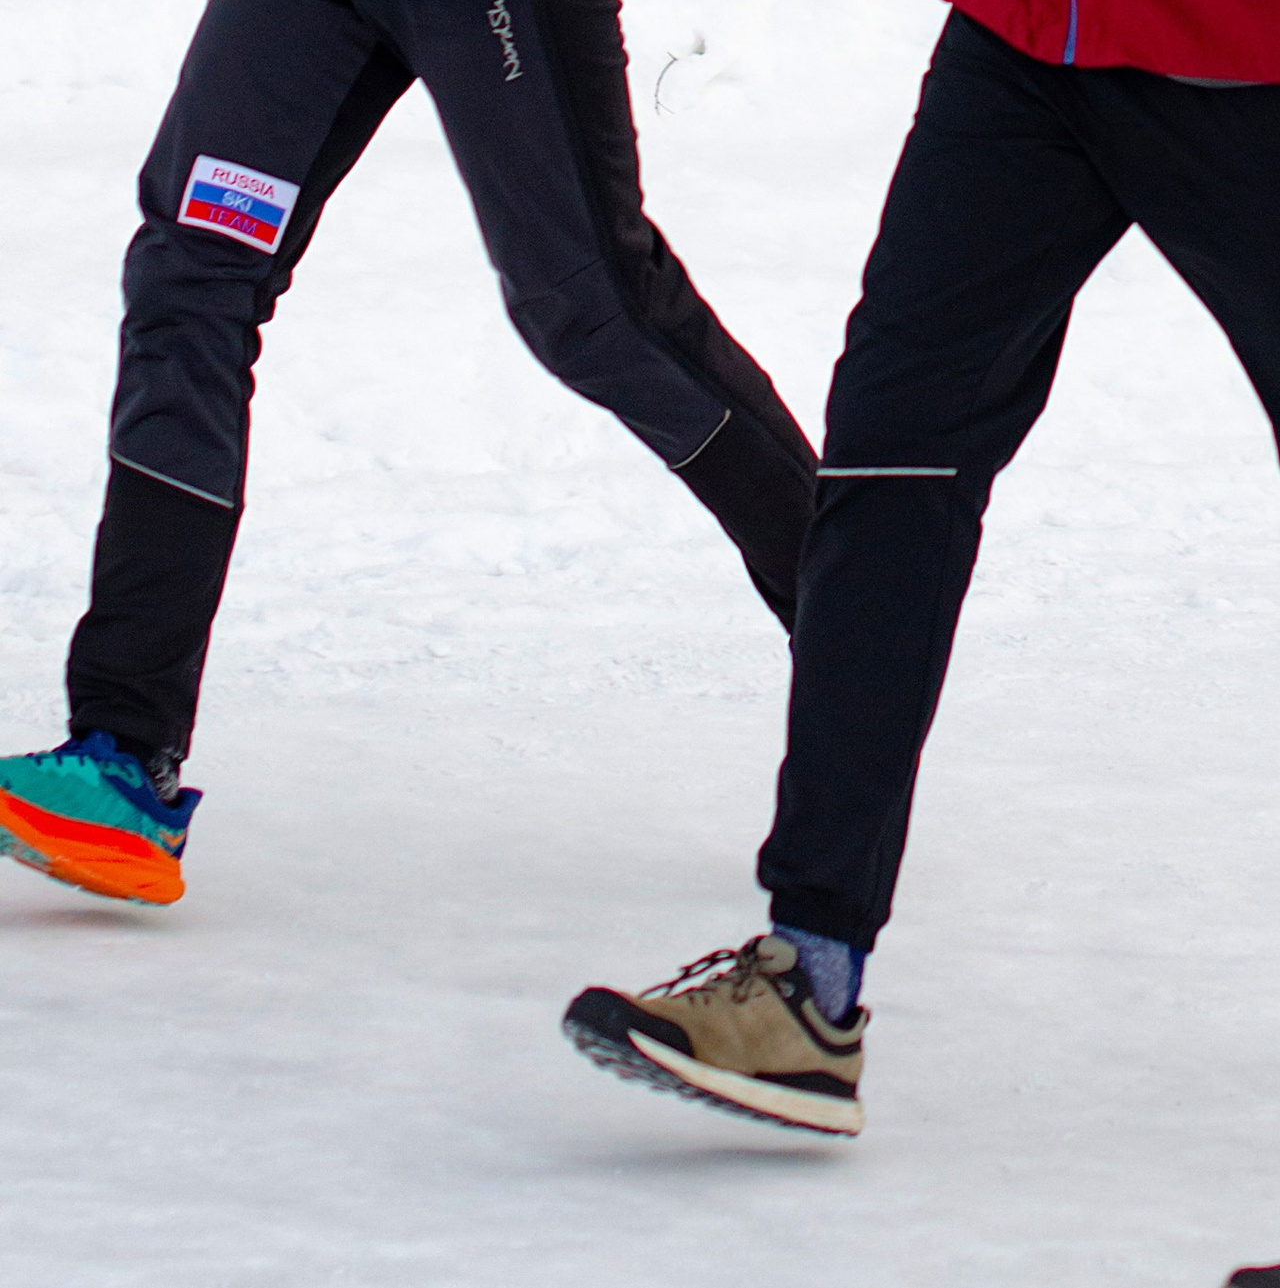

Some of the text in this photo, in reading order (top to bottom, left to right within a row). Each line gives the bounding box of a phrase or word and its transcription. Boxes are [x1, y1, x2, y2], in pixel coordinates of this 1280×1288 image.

[211, 168, 276, 200] RUSSIA
[221, 190, 254, 213] SKI
[207, 206, 259, 236] TEAM
